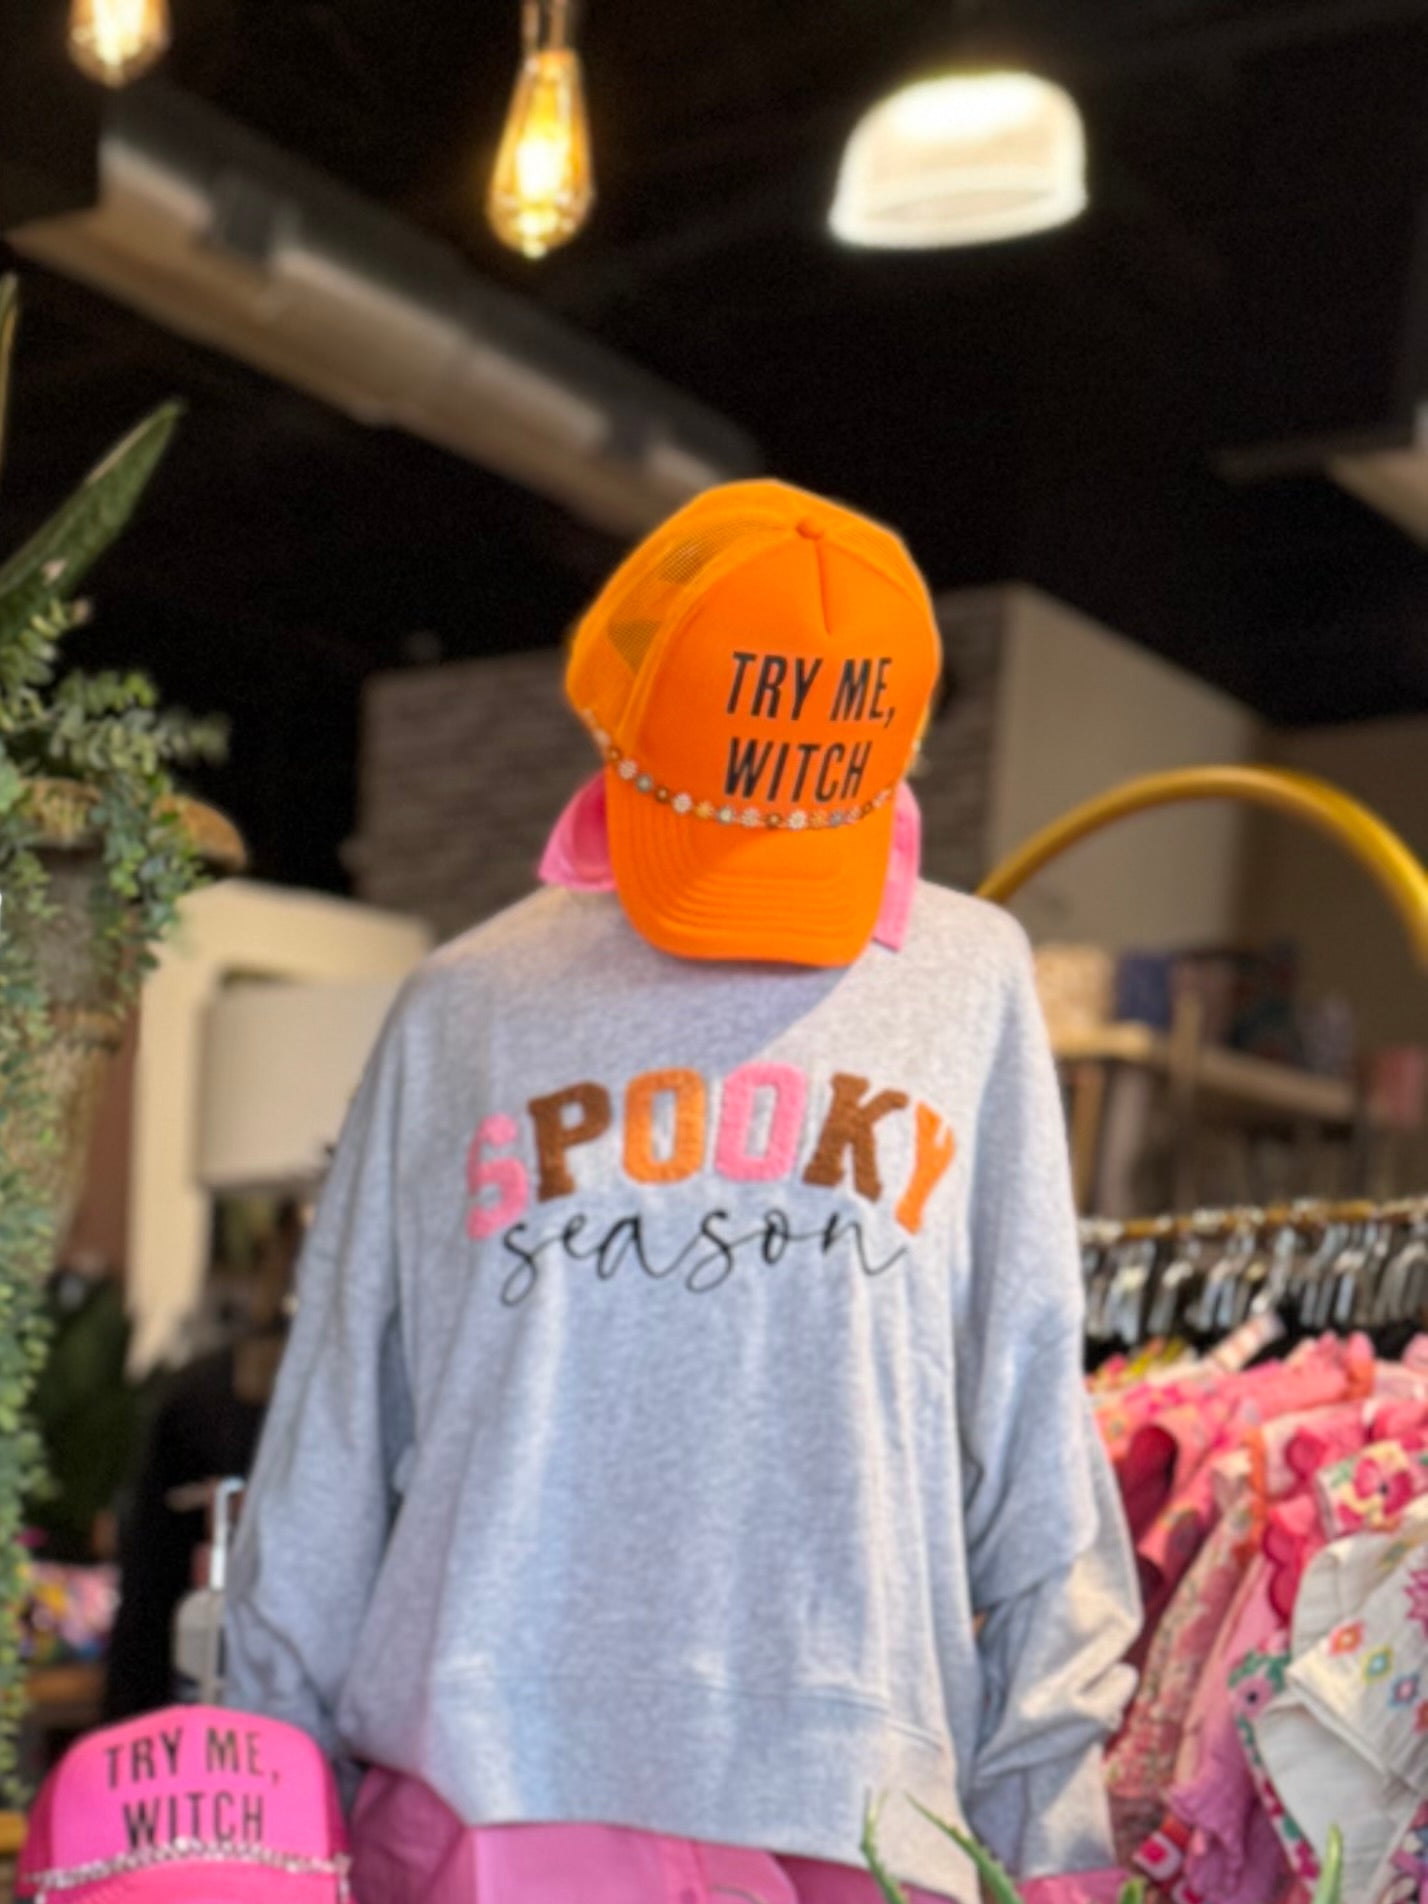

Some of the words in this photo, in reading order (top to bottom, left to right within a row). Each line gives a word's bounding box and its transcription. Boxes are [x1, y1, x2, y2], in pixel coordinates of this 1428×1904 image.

[726, 650, 824, 722] TRY
[828, 656, 896, 729] ME,
[723, 736, 873, 804] WITCH
[464, 1058, 957, 1243] SPOOKY
[499, 1206, 908, 1308] season
[104, 1726, 183, 1791] TRY
[204, 1726, 281, 1786] ME,
[122, 1791, 265, 1850] WITCH
